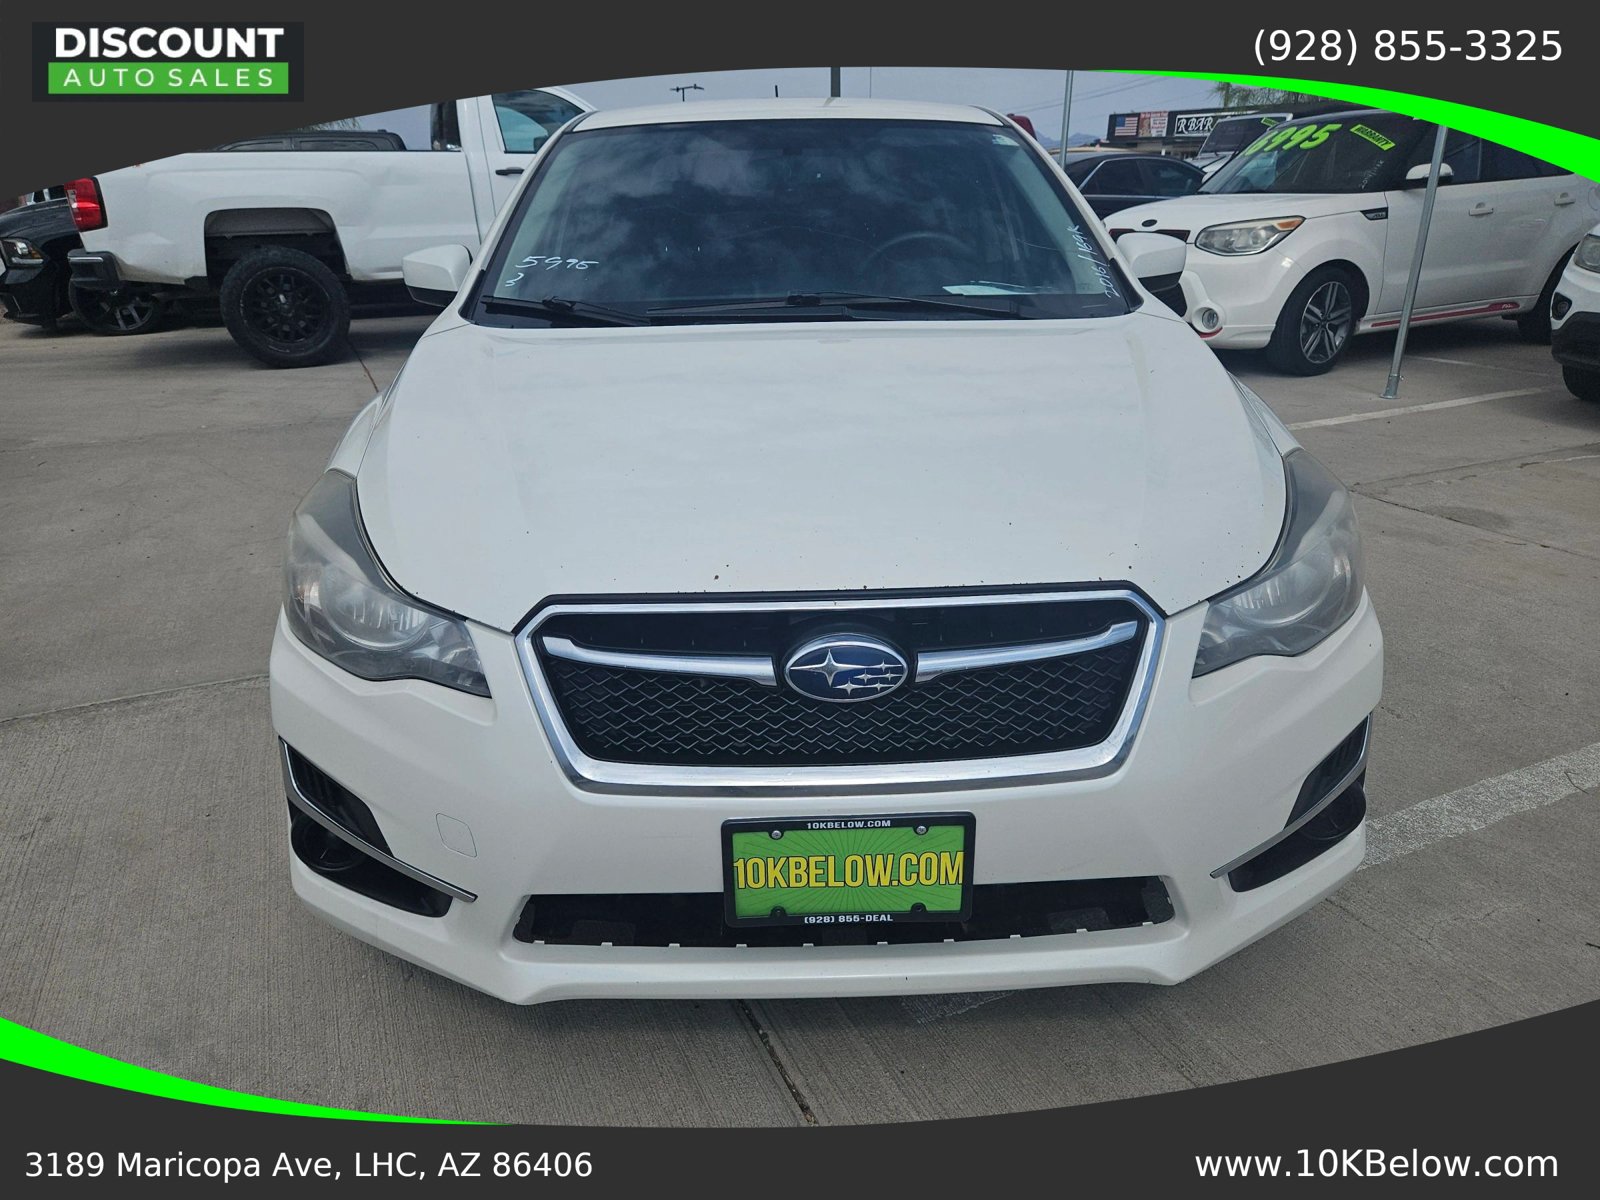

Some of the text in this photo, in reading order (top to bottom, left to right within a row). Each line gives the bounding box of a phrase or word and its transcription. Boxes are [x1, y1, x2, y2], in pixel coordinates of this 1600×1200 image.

[806, 820, 891, 829] 10KBELOW.COM
[733, 851, 964, 889] 10KBELOW.COM
[804, 914, 893, 924] (928) 855-DEAL
